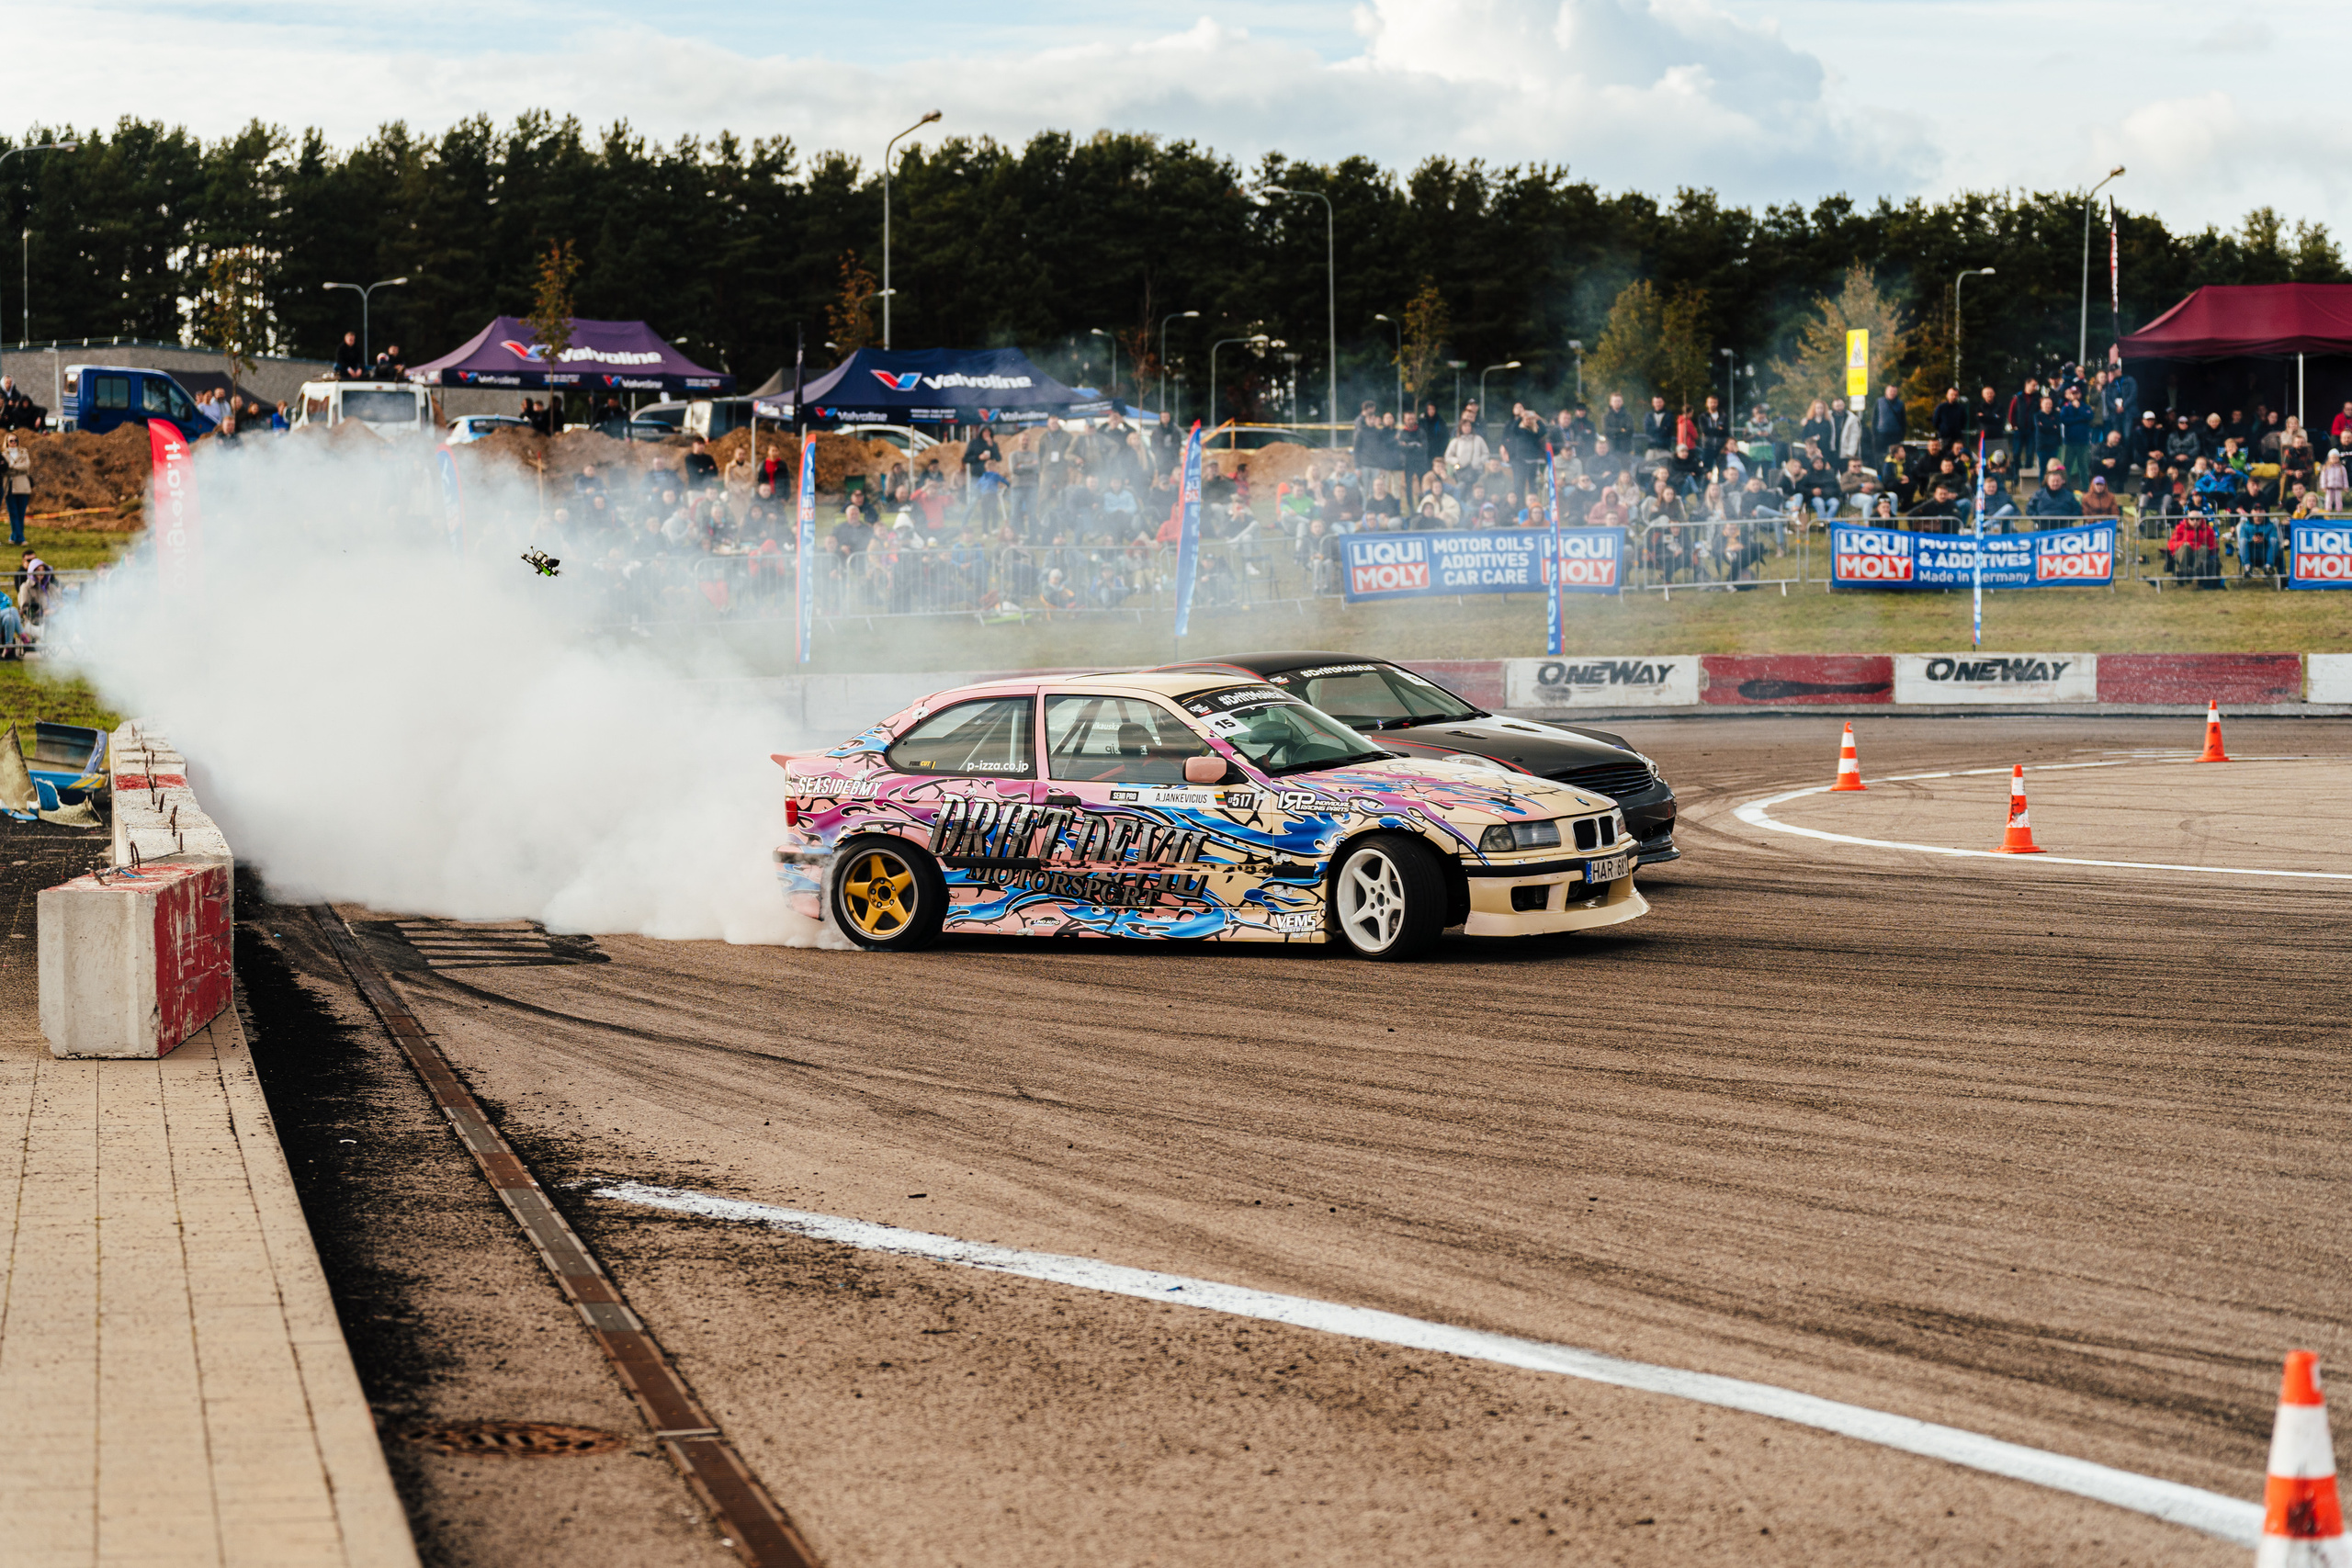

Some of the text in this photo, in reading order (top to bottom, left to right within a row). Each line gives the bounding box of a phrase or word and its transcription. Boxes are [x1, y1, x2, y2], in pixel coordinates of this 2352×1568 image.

[558, 346, 662, 365] Valvoline
[922, 373, 1032, 389] Valvoline
[837, 411, 888, 422] Valvoline
[1432, 536, 1534, 554] MOTOR OILS
[1839, 533, 1908, 557] LIQUI
[2040, 532, 2108, 555] LIQUI
[1352, 540, 1423, 566] LIQUI
[1441, 552, 1530, 570] ADDITIVES
[1918, 551, 2031, 569] & ADDTIVES
[1840, 556, 1910, 579] MOLY
[2041, 553, 2110, 577] MOLY
[1354, 563, 1427, 590] MOLY
[1443, 568, 1528, 586] CAR CARE
[1919, 570, 1954, 582] Made
[1957, 570, 1969, 582] in
[1215, 718, 1236, 729] 15
[967, 760, 1029, 773] p-izza.co.jp
[797, 776, 883, 797] SEASIDEBMX
[1112, 792, 1137, 800] SEMI PRO
[1155, 792, 1208, 804] A.JANKEVICIUS
[927, 793, 1212, 898] DRIFT DEVIL
[1592, 860, 1613, 881] HAR
[965, 866, 1162, 908] MOTORSPORT
